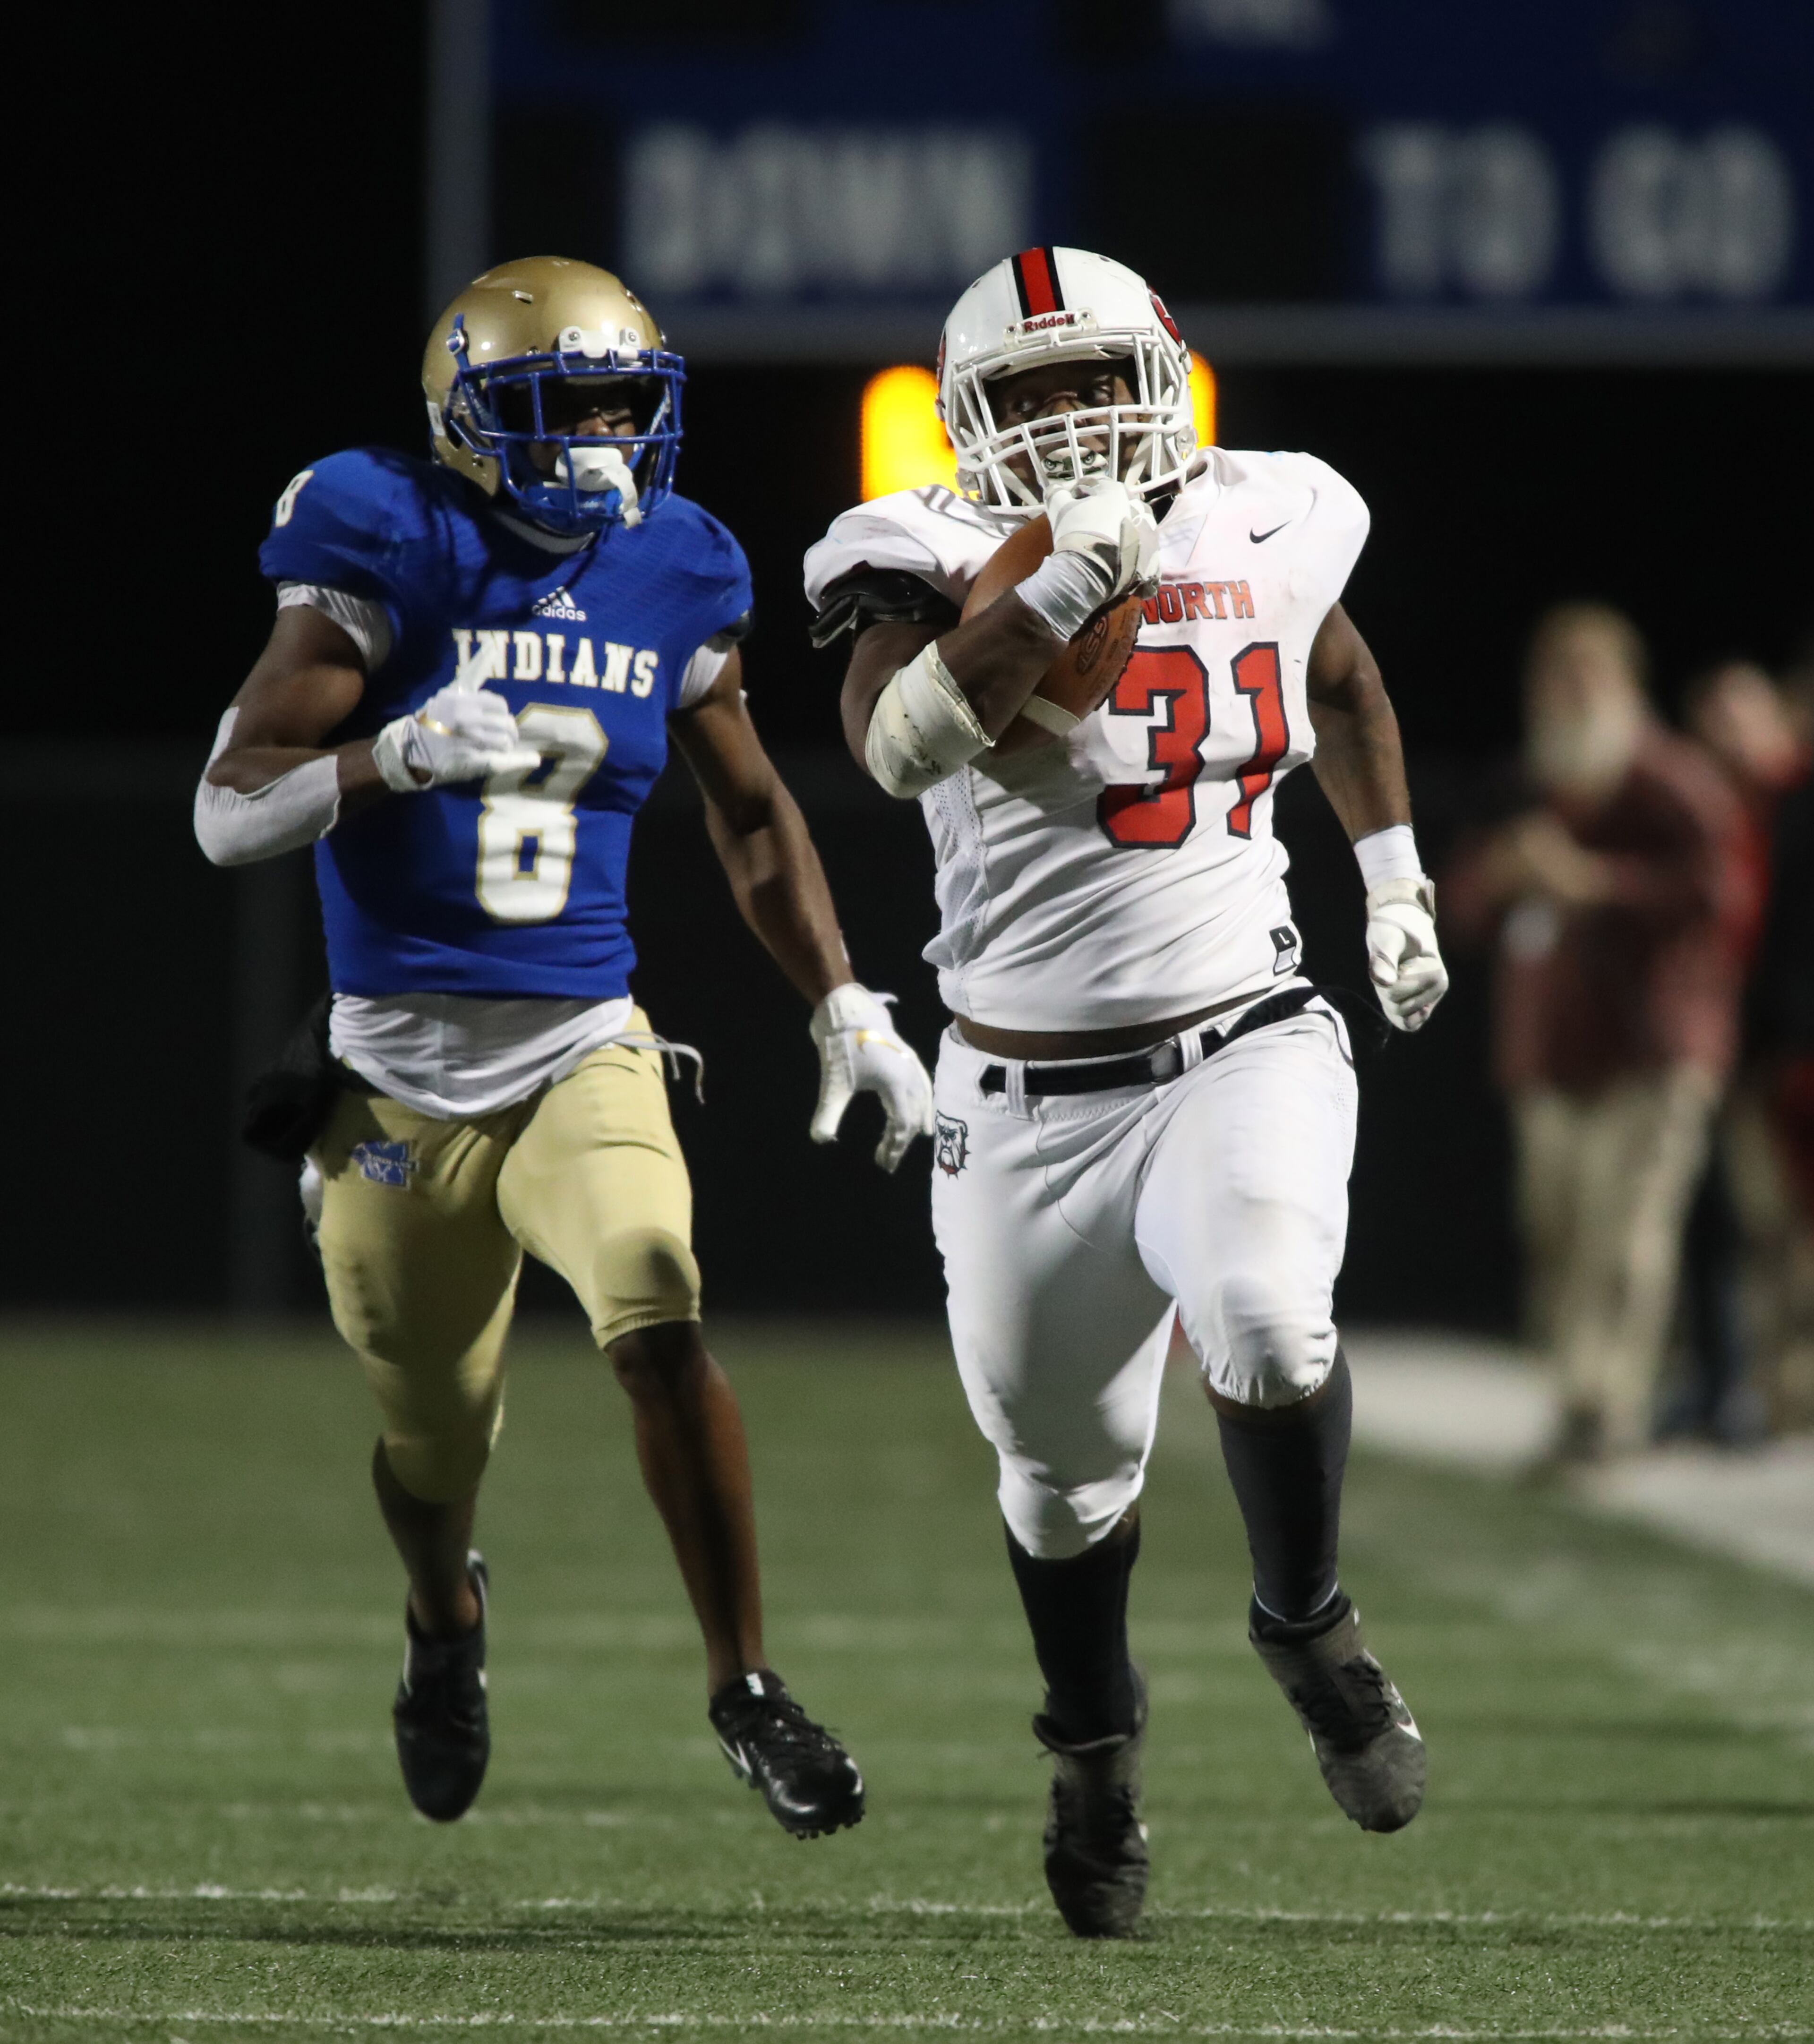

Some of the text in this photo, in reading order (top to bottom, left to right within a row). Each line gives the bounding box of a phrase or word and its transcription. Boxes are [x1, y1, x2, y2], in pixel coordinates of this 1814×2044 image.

[1023, 313, 1075, 333] Riddell
[275, 470, 314, 527] 8
[531, 604, 587, 622] adidas
[452, 628, 659, 699] INDIANS
[1096, 641, 1291, 850] 31
[475, 702, 609, 925] 8
